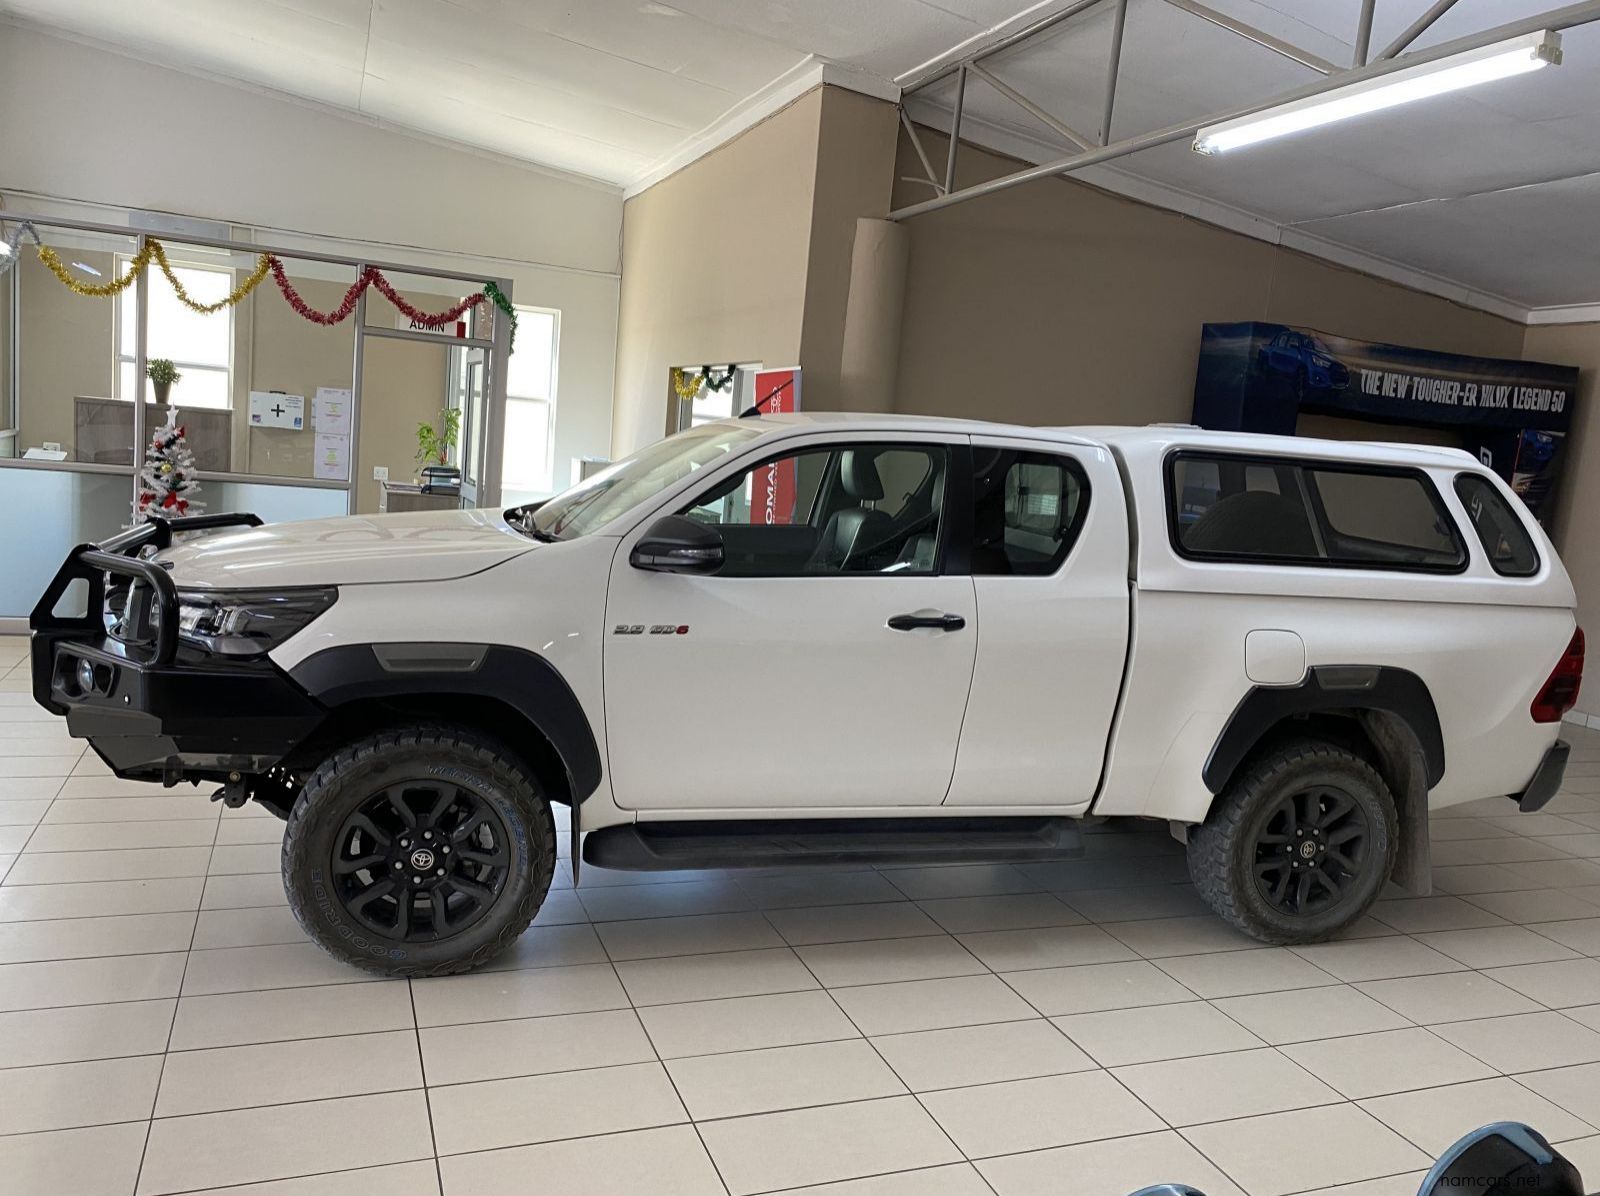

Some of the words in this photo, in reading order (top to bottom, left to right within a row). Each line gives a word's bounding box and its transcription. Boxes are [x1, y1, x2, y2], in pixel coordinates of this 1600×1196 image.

[409, 319, 445, 333] ADMIN
[1360, 368, 1380, 396] THE
[1381, 372, 1410, 400] NEW
[1411, 376, 1477, 407] TOUGHER-ER
[1479, 383, 1512, 409] HILUX
[1513, 386, 1551, 412] LEGEND
[1550, 390, 1566, 413] 50
